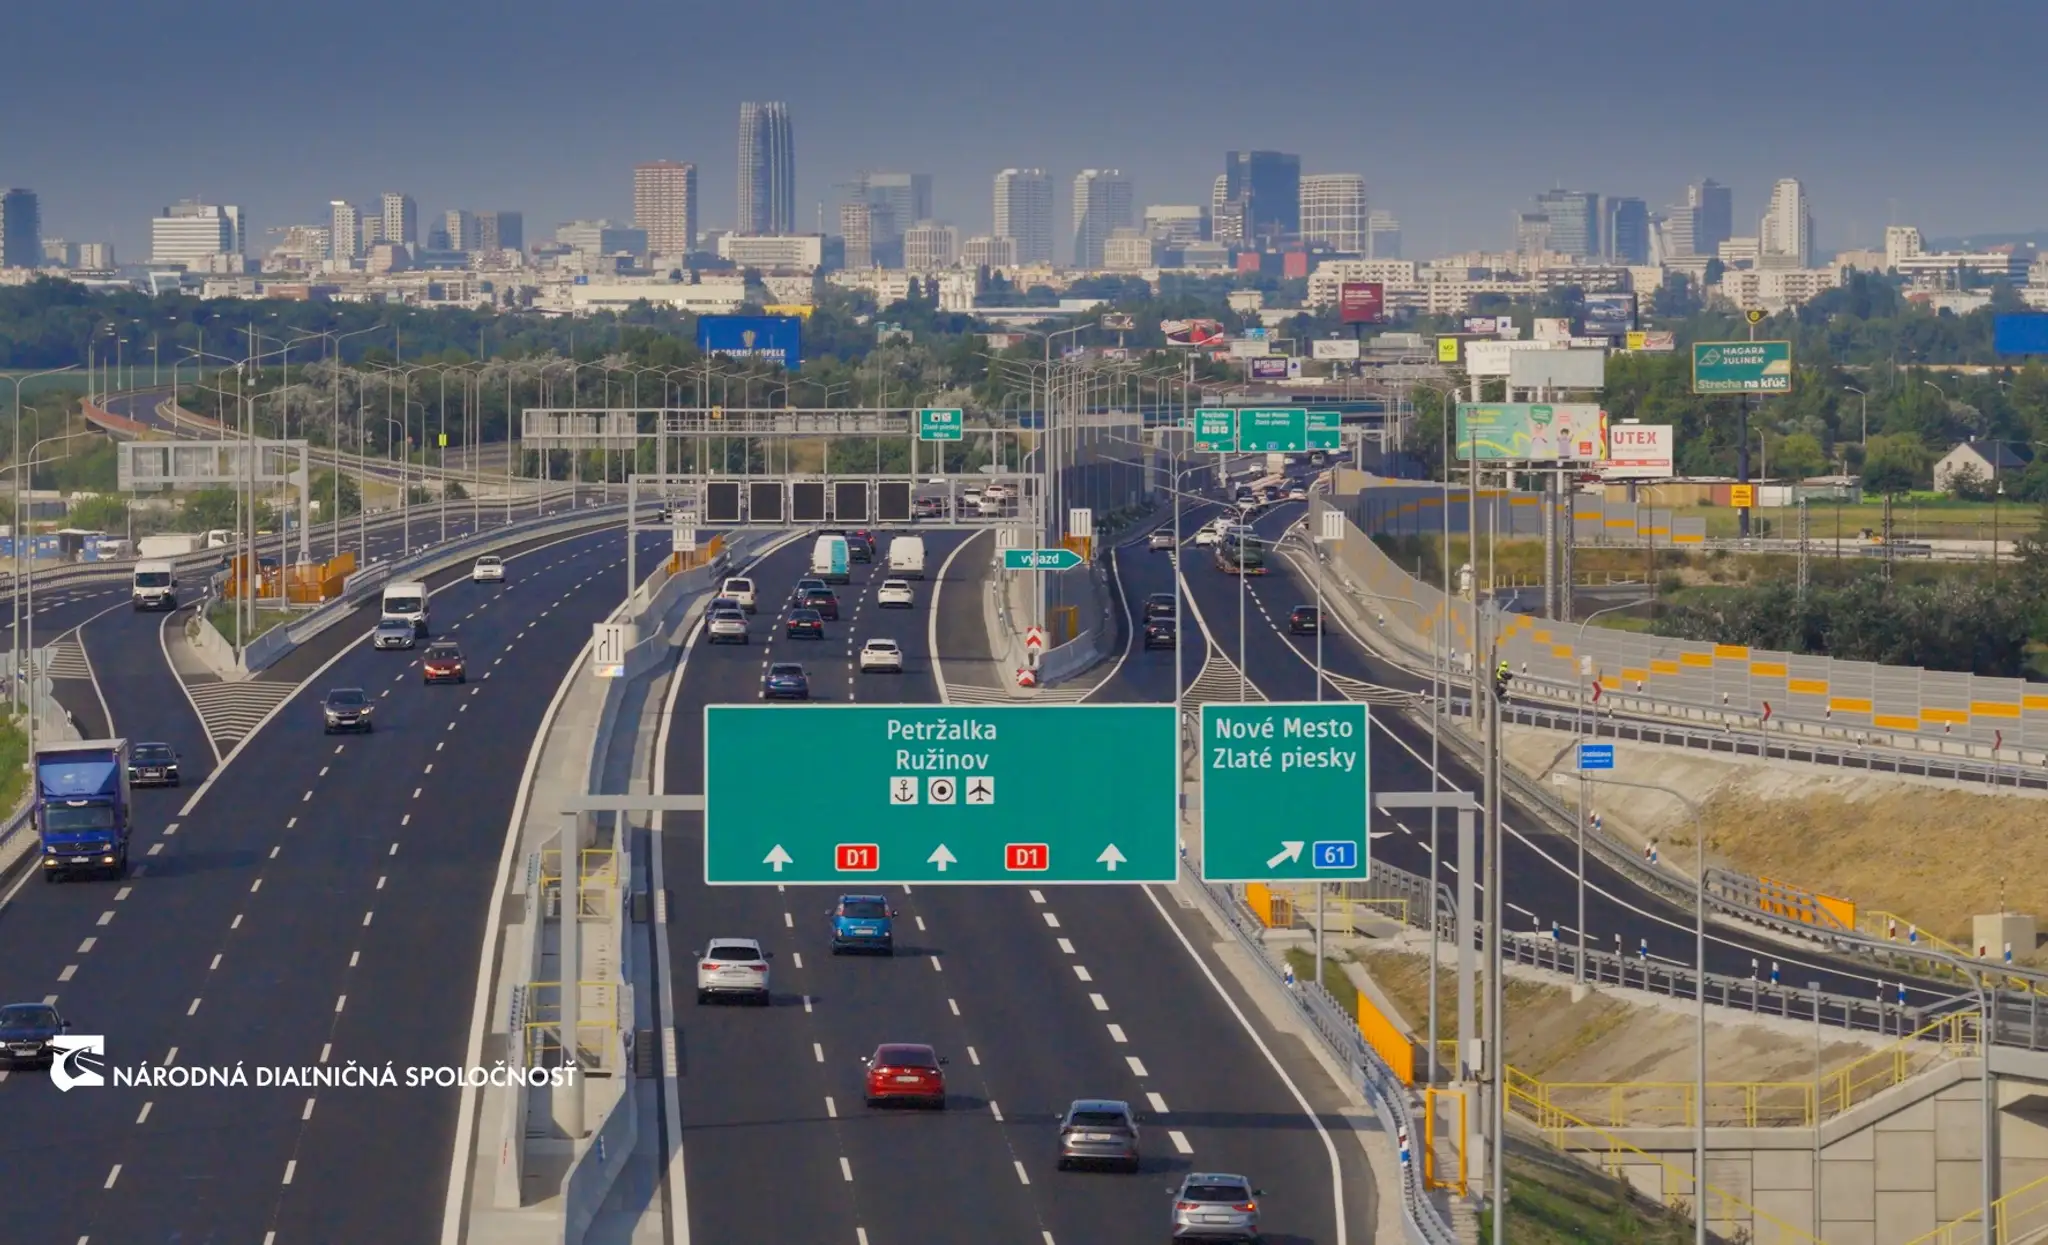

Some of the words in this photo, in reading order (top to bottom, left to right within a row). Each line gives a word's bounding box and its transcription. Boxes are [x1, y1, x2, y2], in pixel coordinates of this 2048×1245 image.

[1723, 347, 1765, 355] HAGARA
[1723, 356, 1764, 365] JULINEK
[1698, 379, 1741, 389] Strecha
[1744, 380, 1758, 389] na
[1761, 377, 1786, 389] kľúč
[1020, 552, 1059, 567] výjazd
[887, 718, 997, 740] Petržalka
[1216, 717, 1274, 739] Nové
[1283, 717, 1353, 738] Mesto
[896, 748, 990, 770] Ružinov
[1213, 746, 1272, 768] Zlaté
[1281, 746, 1356, 772] piesky
[846, 849, 868, 866] D1
[1016, 849, 1038, 866] D1
[1324, 846, 1345, 864] 61
